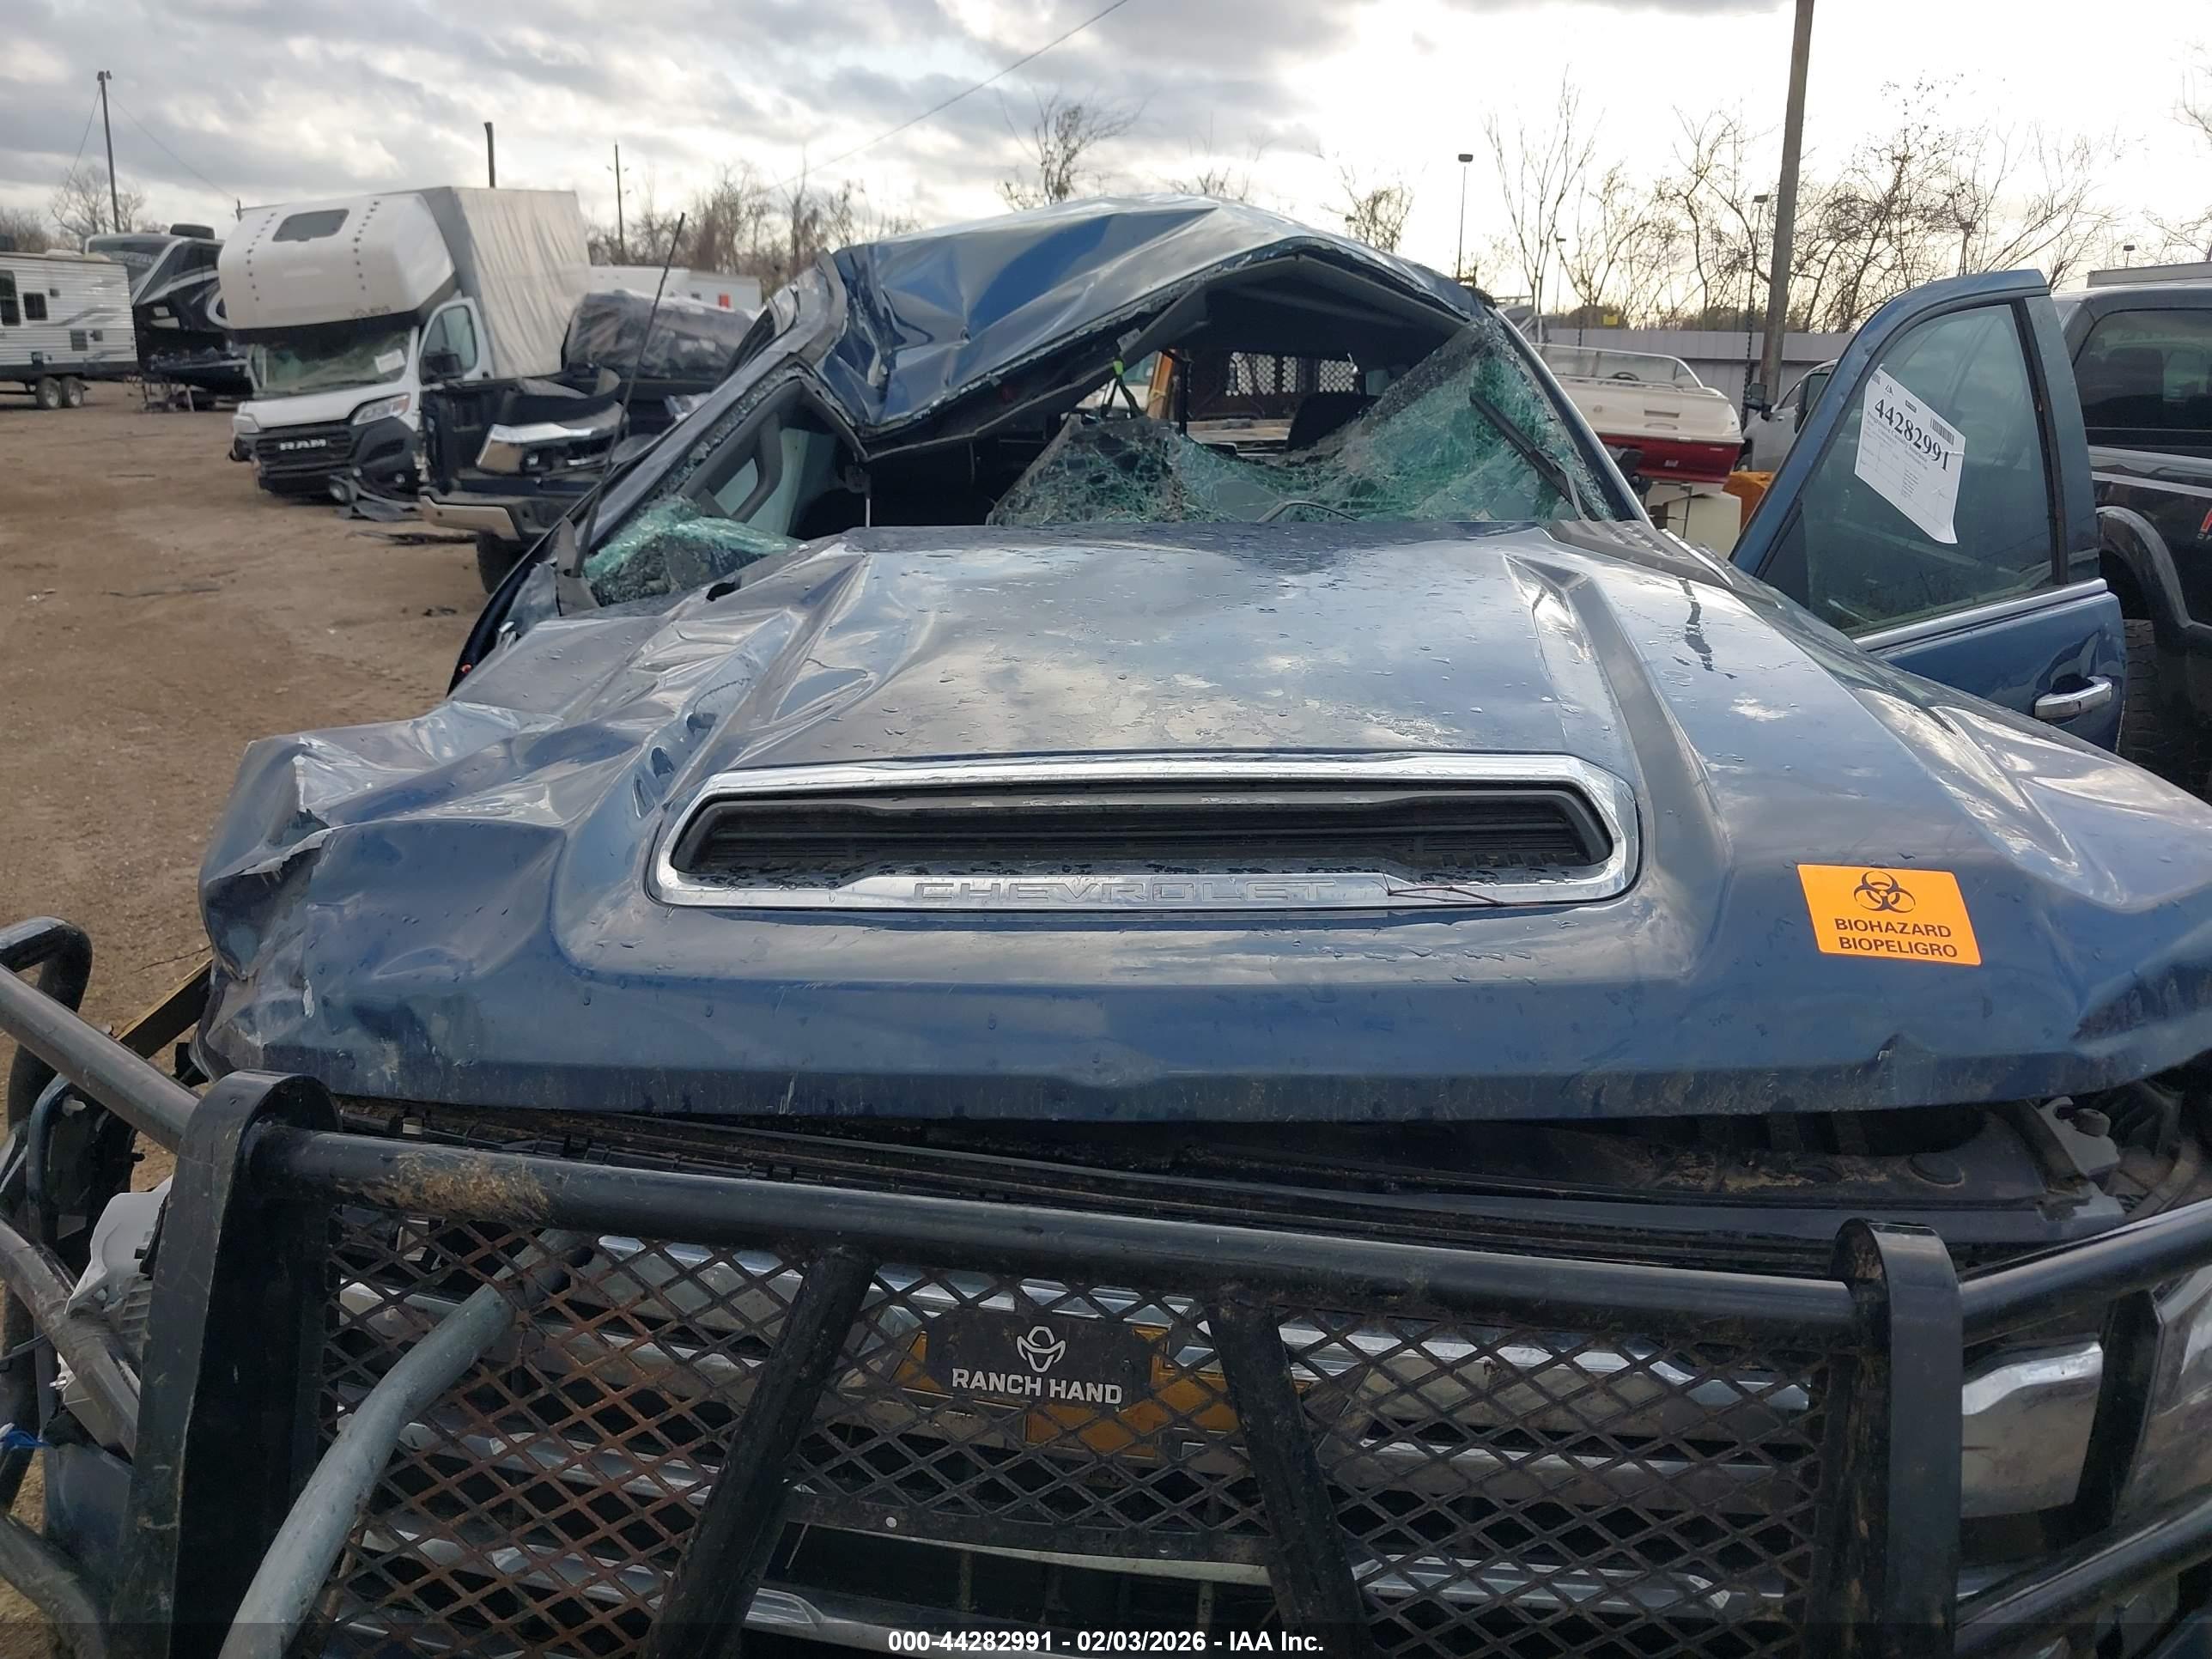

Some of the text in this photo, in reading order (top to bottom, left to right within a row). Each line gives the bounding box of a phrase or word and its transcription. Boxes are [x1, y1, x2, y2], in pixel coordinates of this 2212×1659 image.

[280, 438, 327, 451] RAM
[1875, 398, 1948, 471] 44282991
[915, 881, 1338, 903] CHEVROLET
[1834, 918, 1952, 938] BIOHAZARD
[1838, 936, 1958, 957] BIOPELIGRO
[951, 1368, 1122, 1405] RANCH HAND
